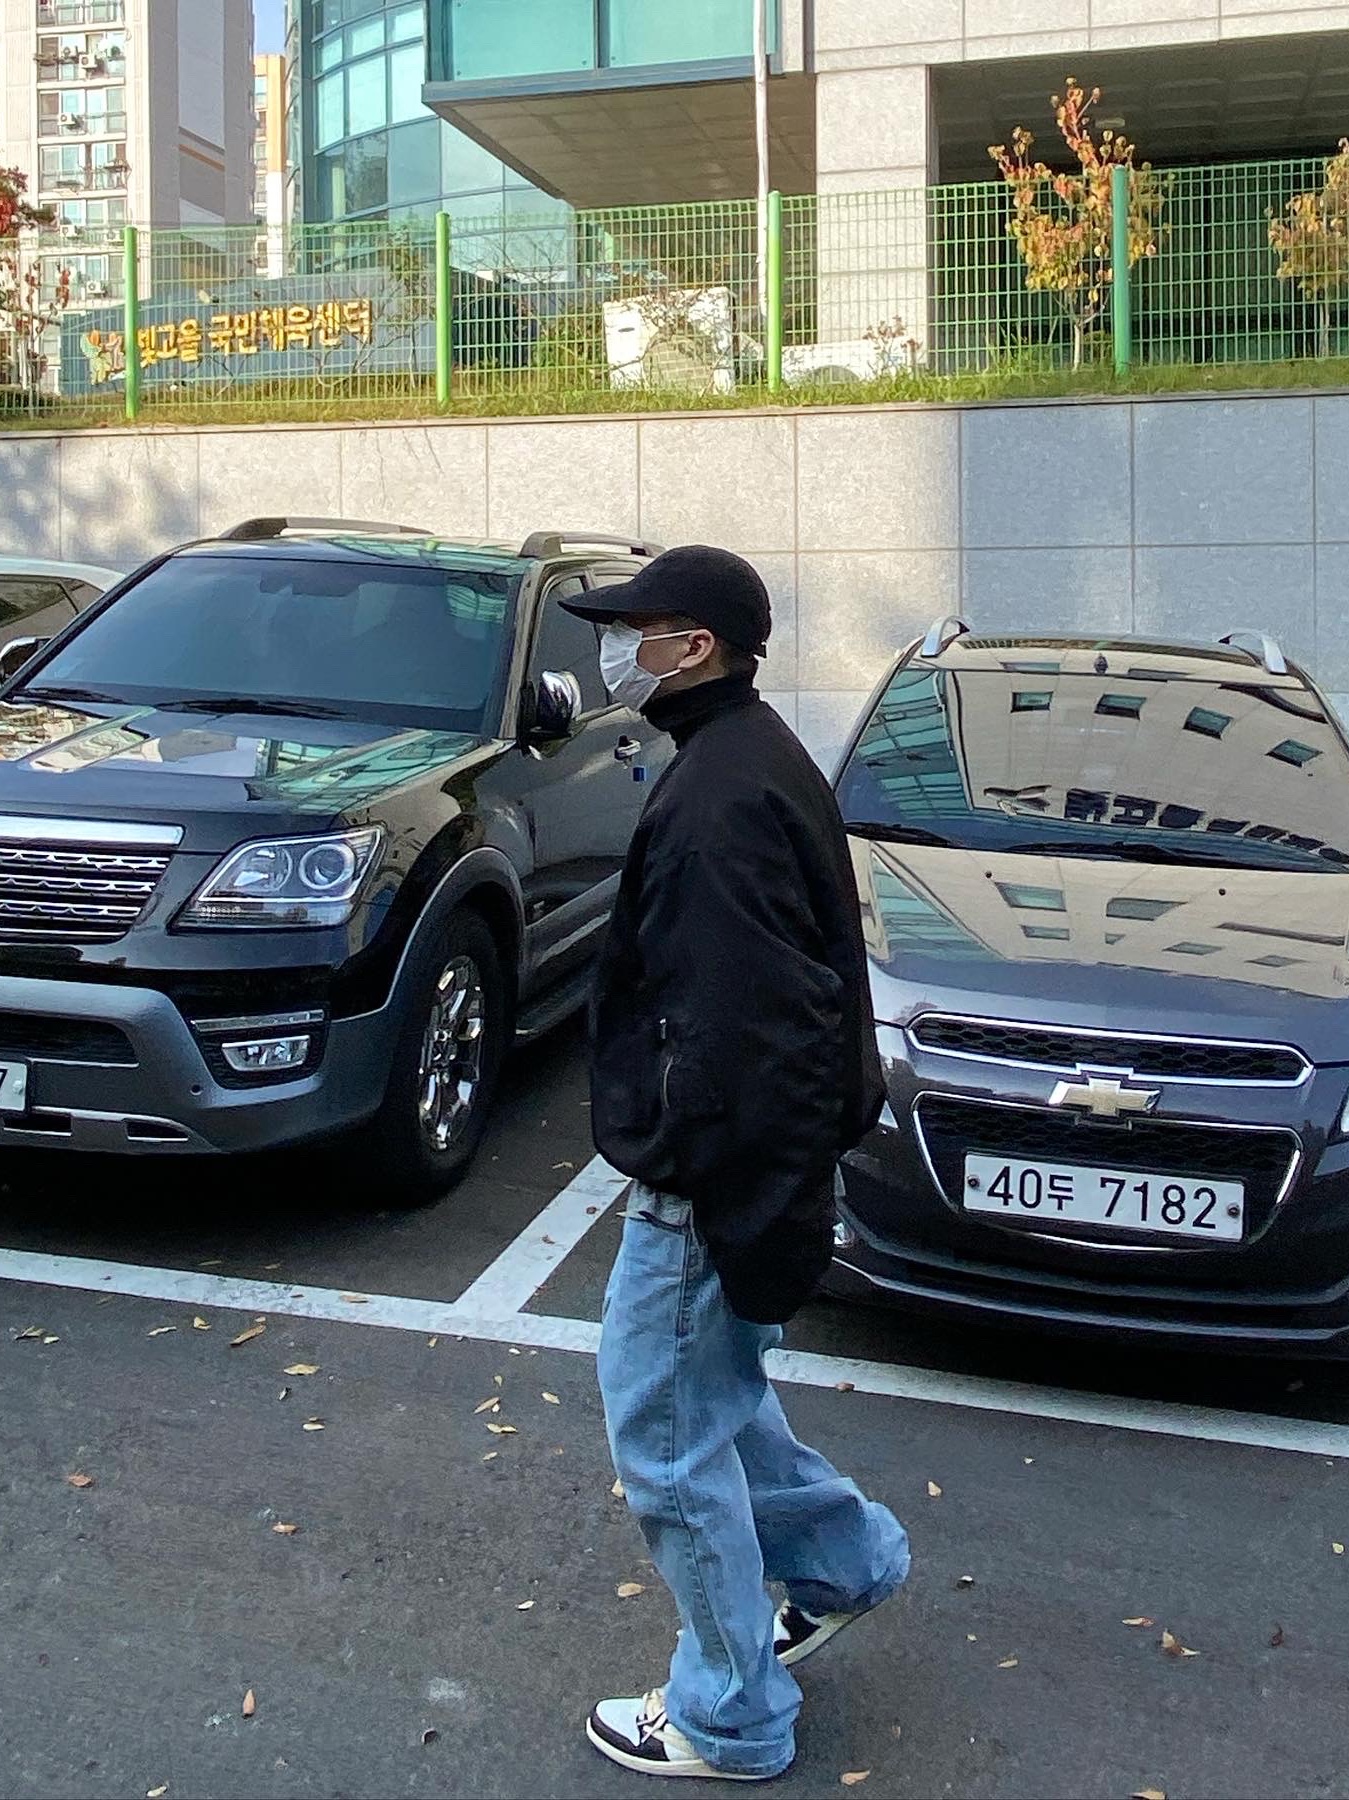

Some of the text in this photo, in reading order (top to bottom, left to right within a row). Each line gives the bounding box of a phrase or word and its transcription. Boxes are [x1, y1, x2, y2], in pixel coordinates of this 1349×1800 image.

[208, 299, 371, 356] 국민체육센터
[987, 1166, 1217, 1229] 40두 7182
